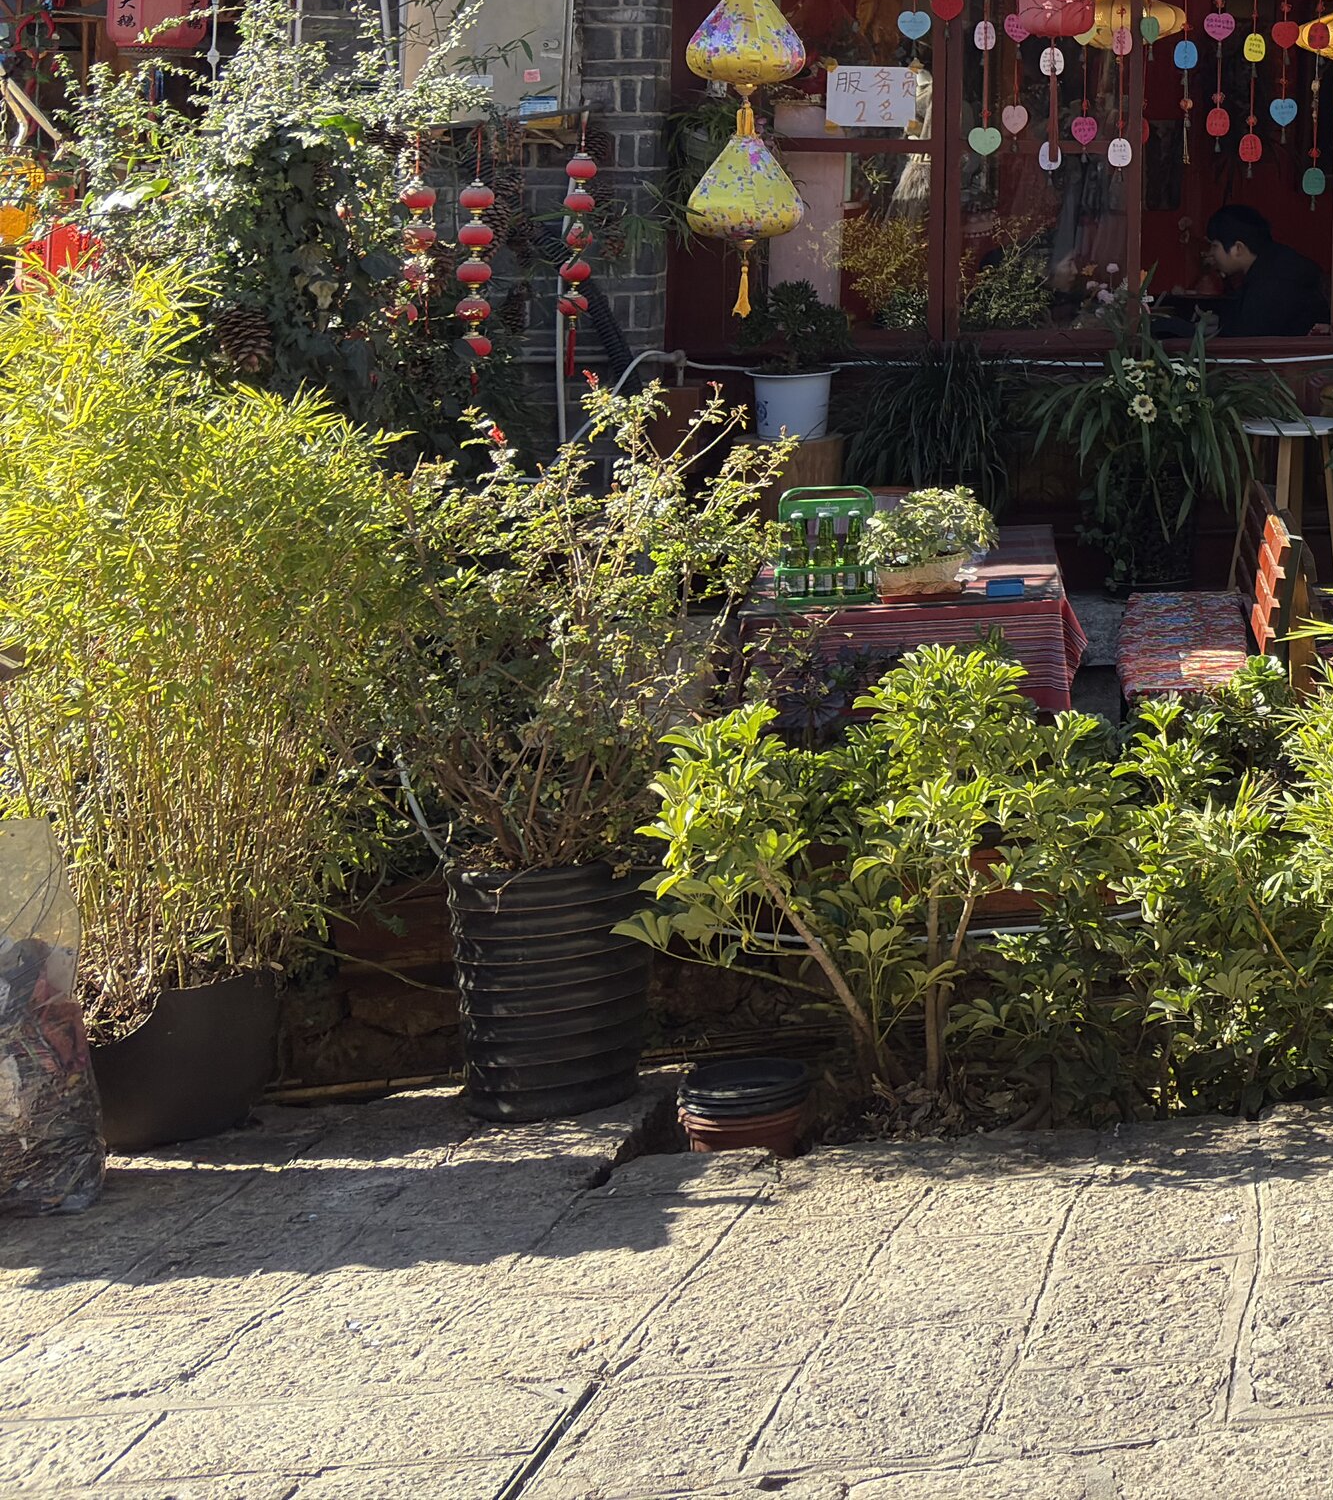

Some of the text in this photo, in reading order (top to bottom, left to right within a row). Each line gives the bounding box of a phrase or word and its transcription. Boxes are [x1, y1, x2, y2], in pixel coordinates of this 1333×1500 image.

[836, 68, 916, 98] 服务员
[855, 99, 895, 122] 2名
